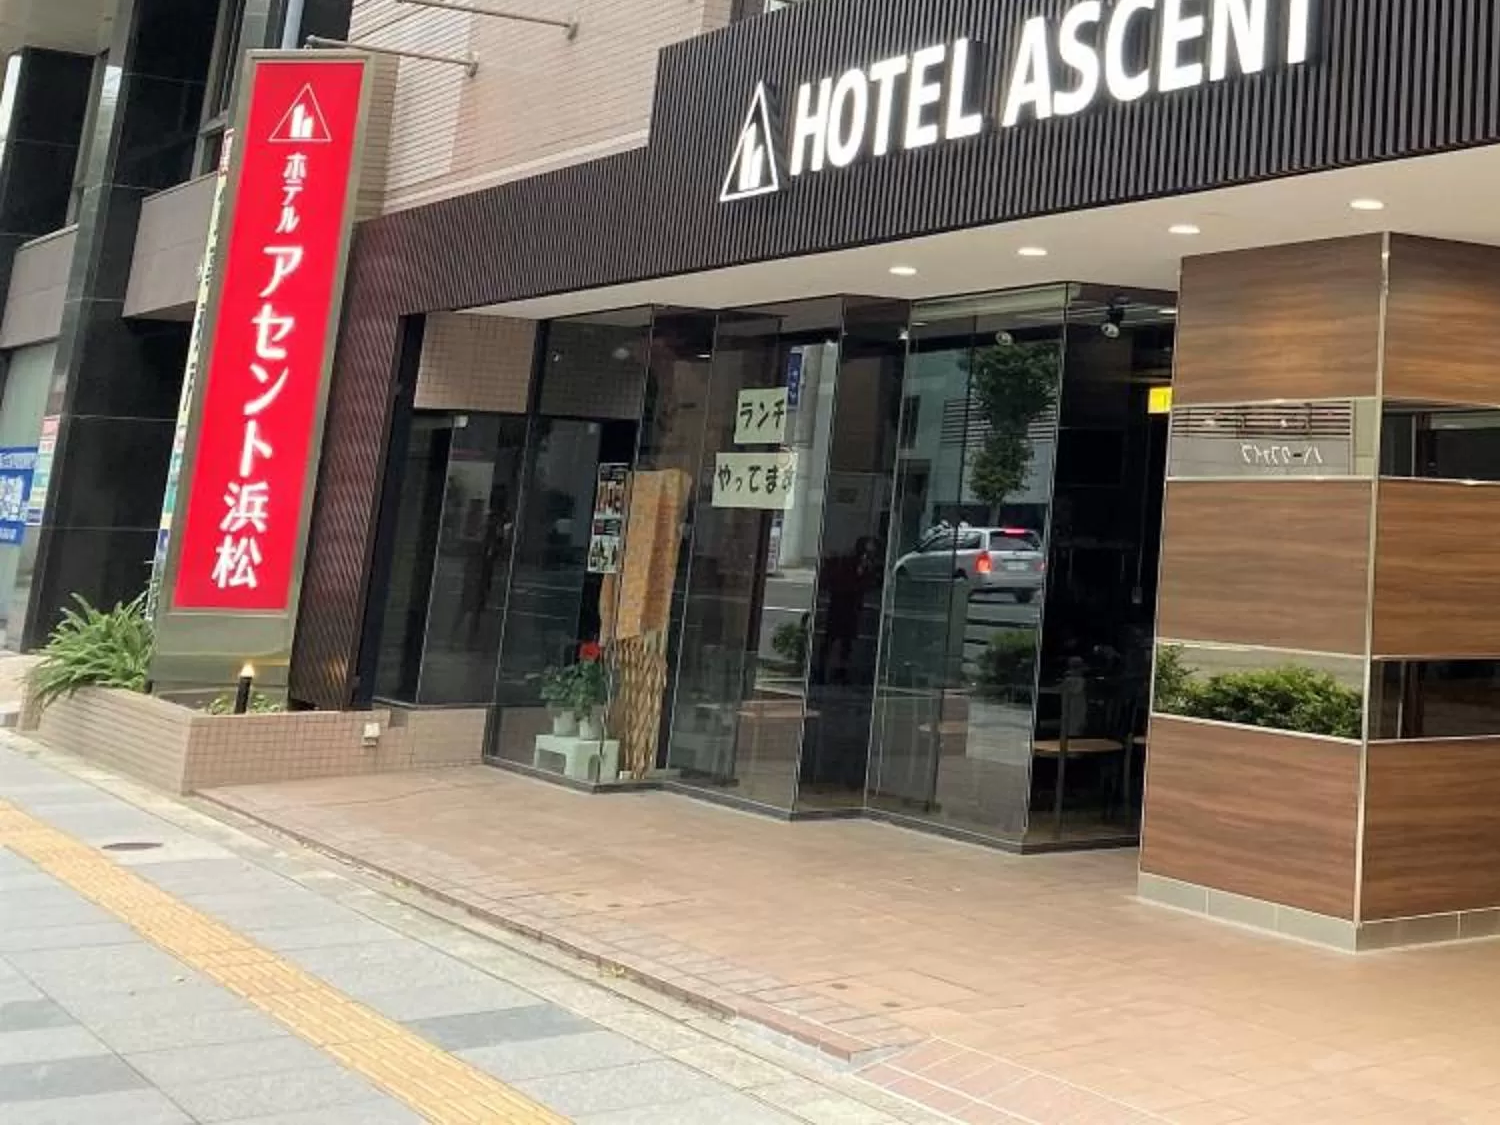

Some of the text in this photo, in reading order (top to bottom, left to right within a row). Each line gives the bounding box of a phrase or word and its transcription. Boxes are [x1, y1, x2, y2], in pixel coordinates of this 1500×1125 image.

[789, 37, 982, 176] HOTEL
[211, 152, 308, 590] ホテルアセント浜松
[739, 399, 785, 428] ランチ
[718, 463, 794, 495] やってます
